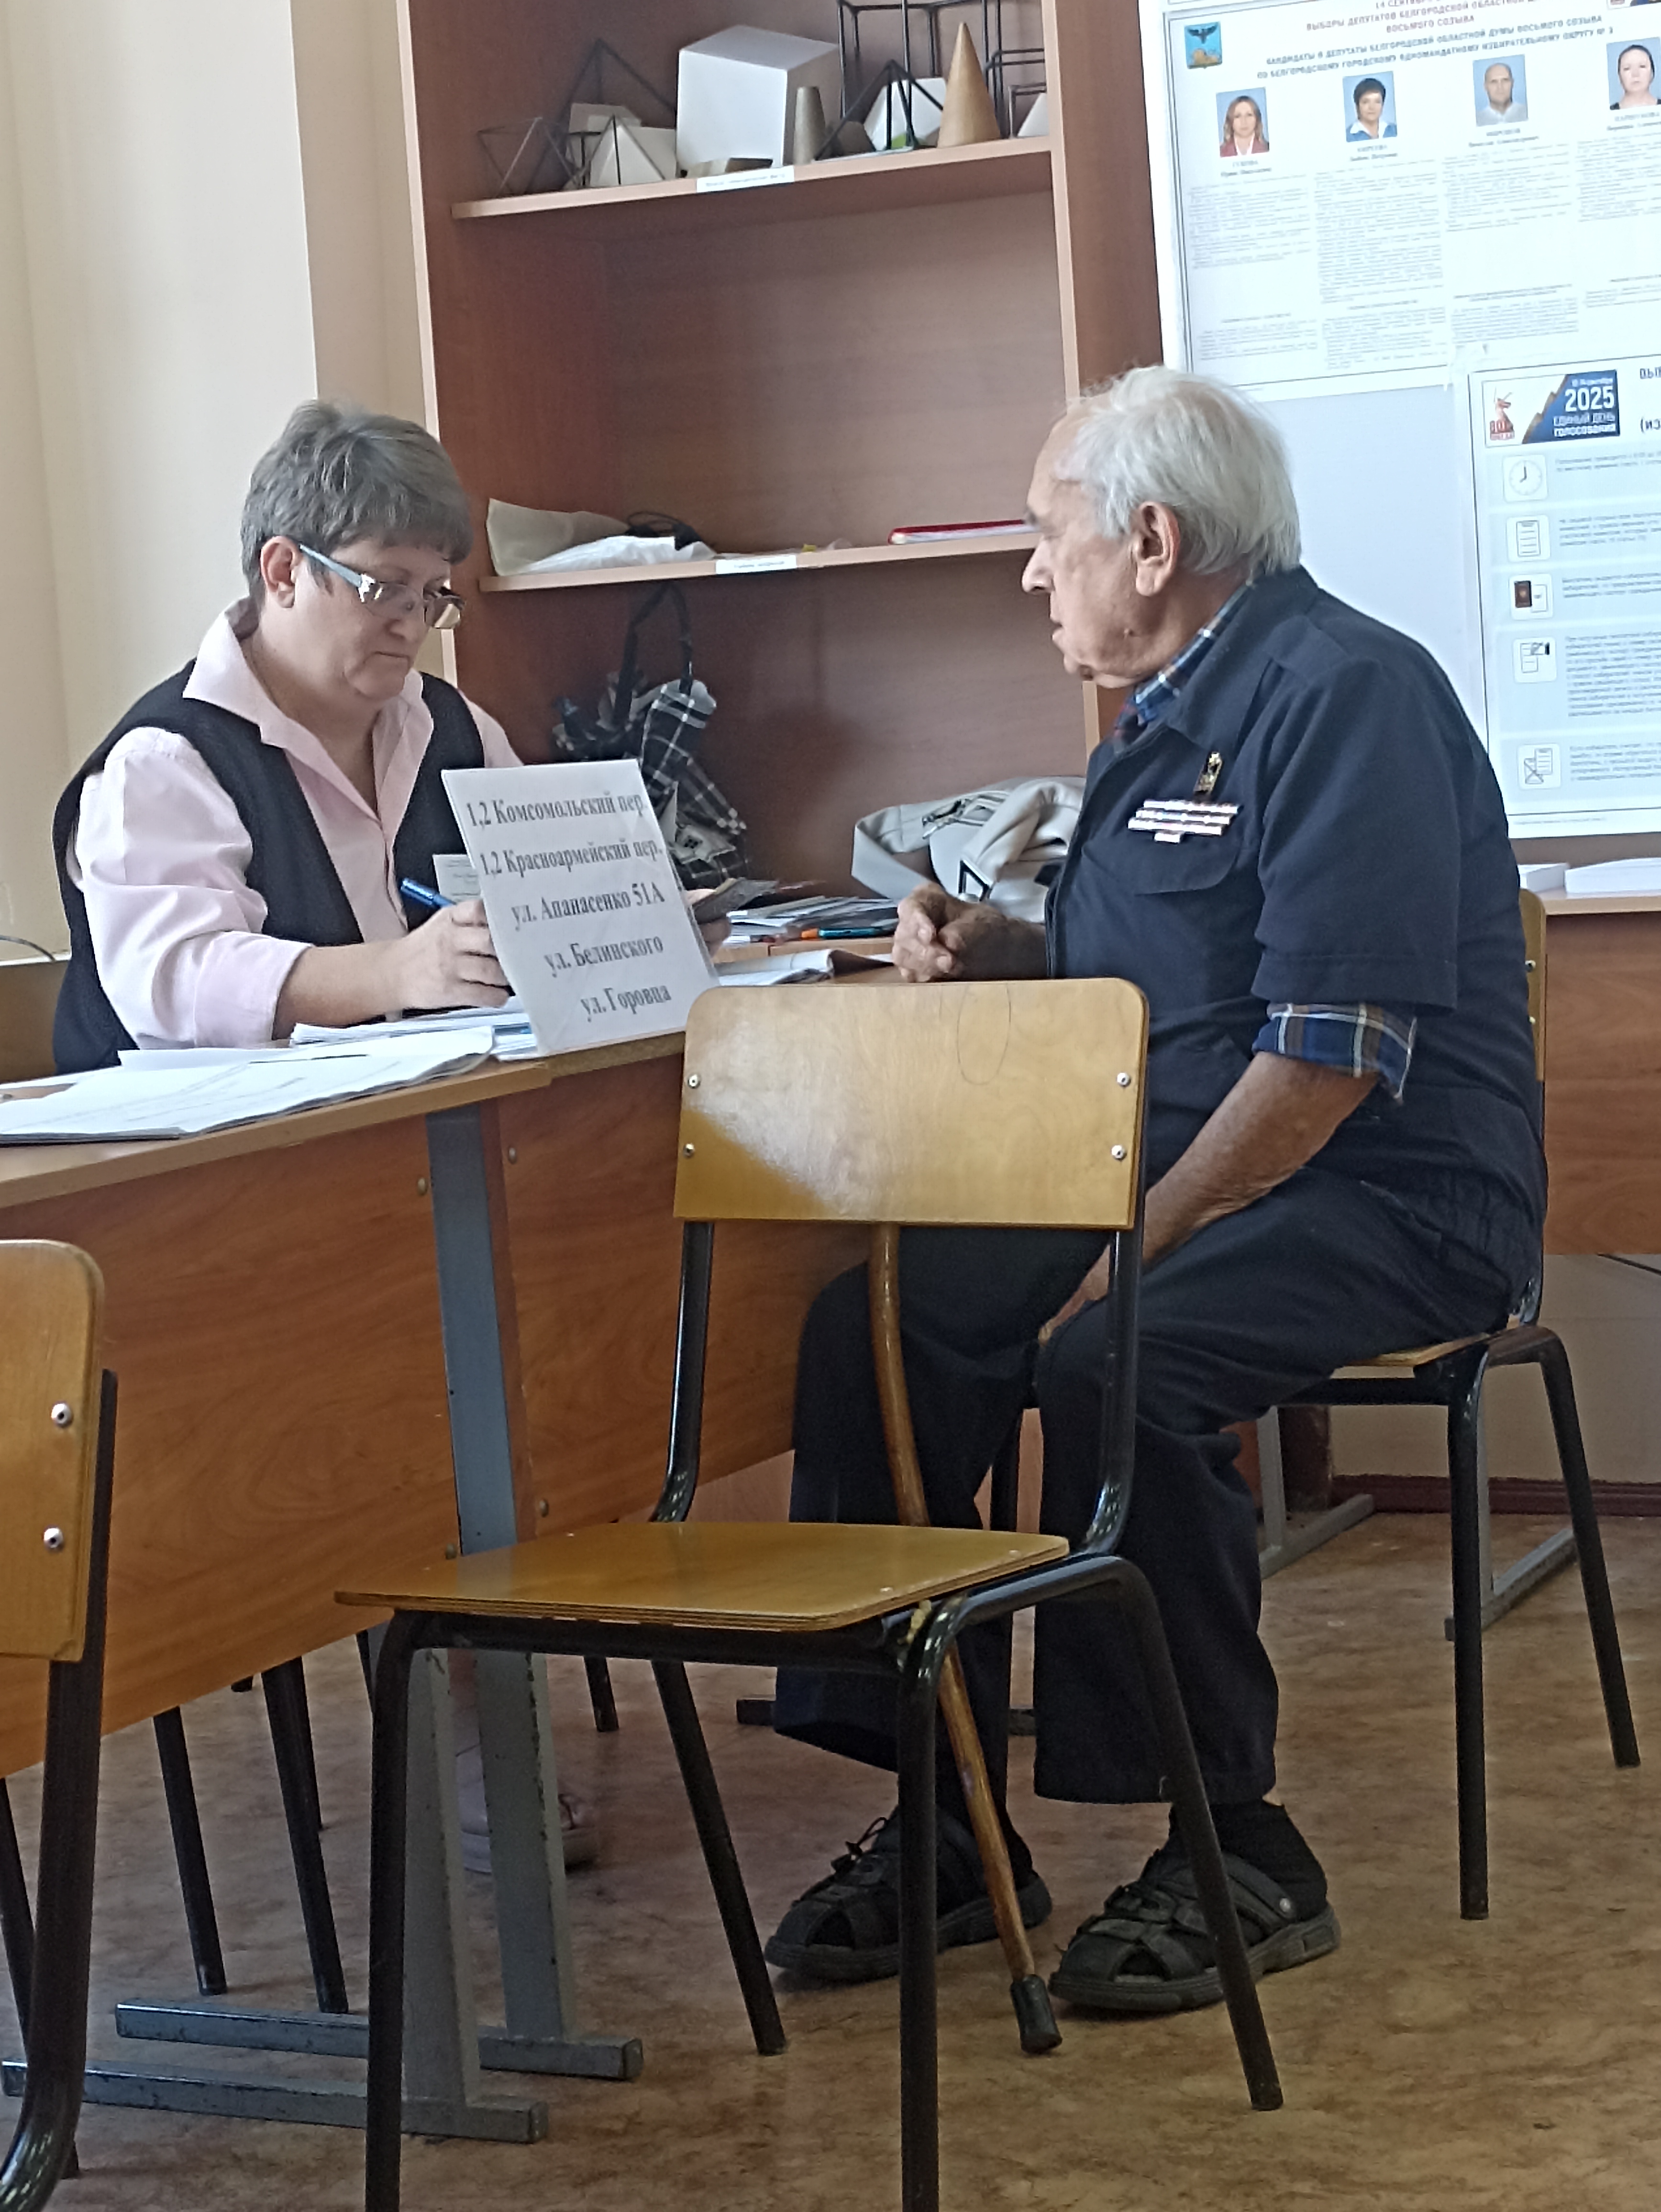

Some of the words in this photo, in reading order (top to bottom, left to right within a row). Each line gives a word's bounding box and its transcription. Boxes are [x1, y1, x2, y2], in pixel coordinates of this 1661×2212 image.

[1564, 386, 1615, 412] 2025
[492, 789, 616, 824] Комсомольский
[503, 837, 631, 878] Красноармейский
[632, 840, 664, 862] пер.
[510, 904, 537, 931] ул.
[631, 881, 665, 907] 51А
[543, 952, 572, 978] ул.
[570, 936, 664, 967] Белинского
[580, 996, 607, 1023] ул.
[603, 985, 672, 1015] Горовца
